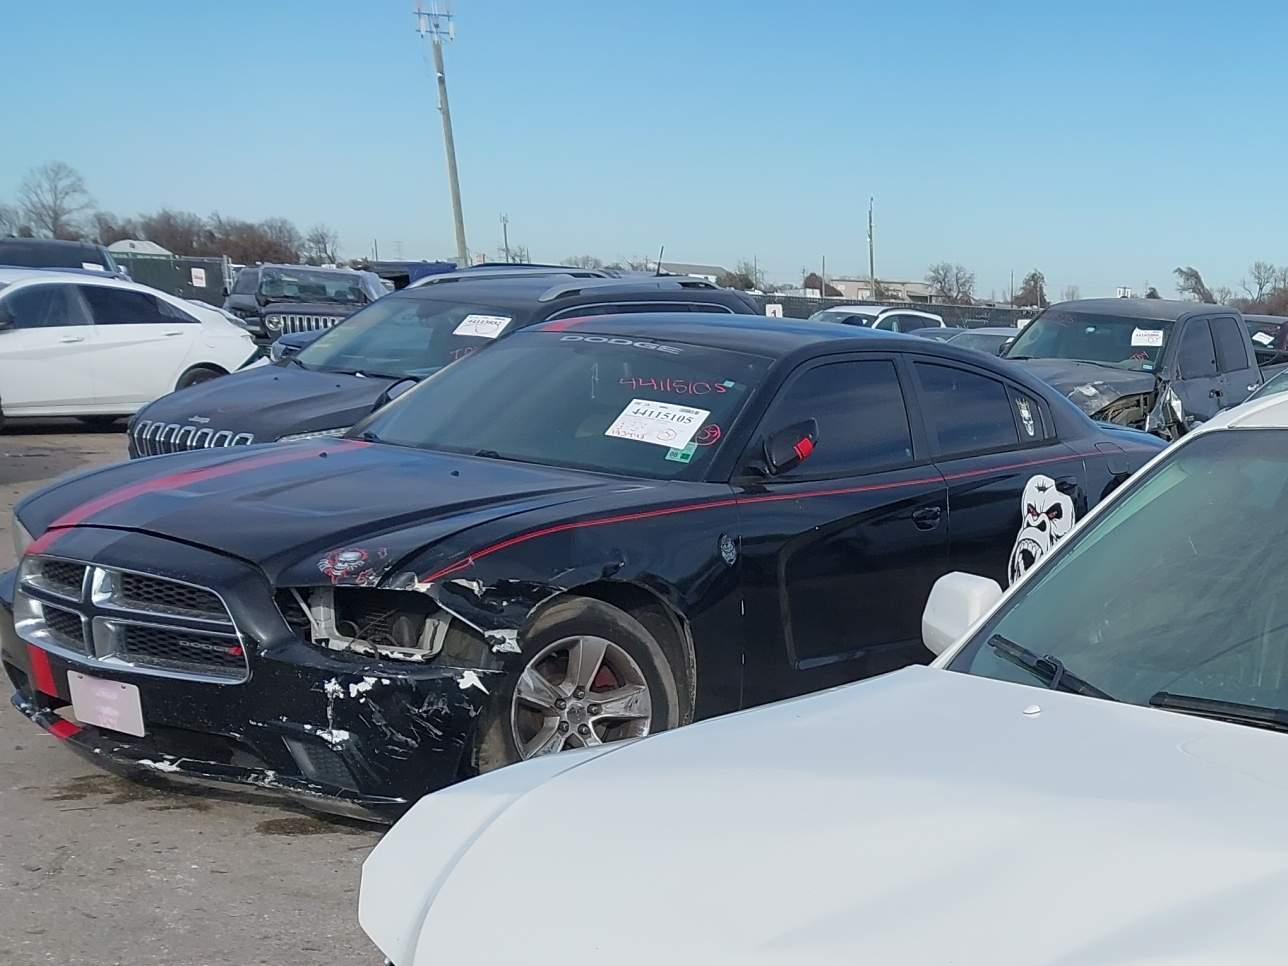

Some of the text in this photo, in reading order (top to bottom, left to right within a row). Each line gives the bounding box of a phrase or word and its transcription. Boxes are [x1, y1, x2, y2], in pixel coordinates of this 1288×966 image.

[560, 335, 683, 355] DODGE
[619, 378, 728, 395] 44115105
[632, 408, 695, 425] 44115105
